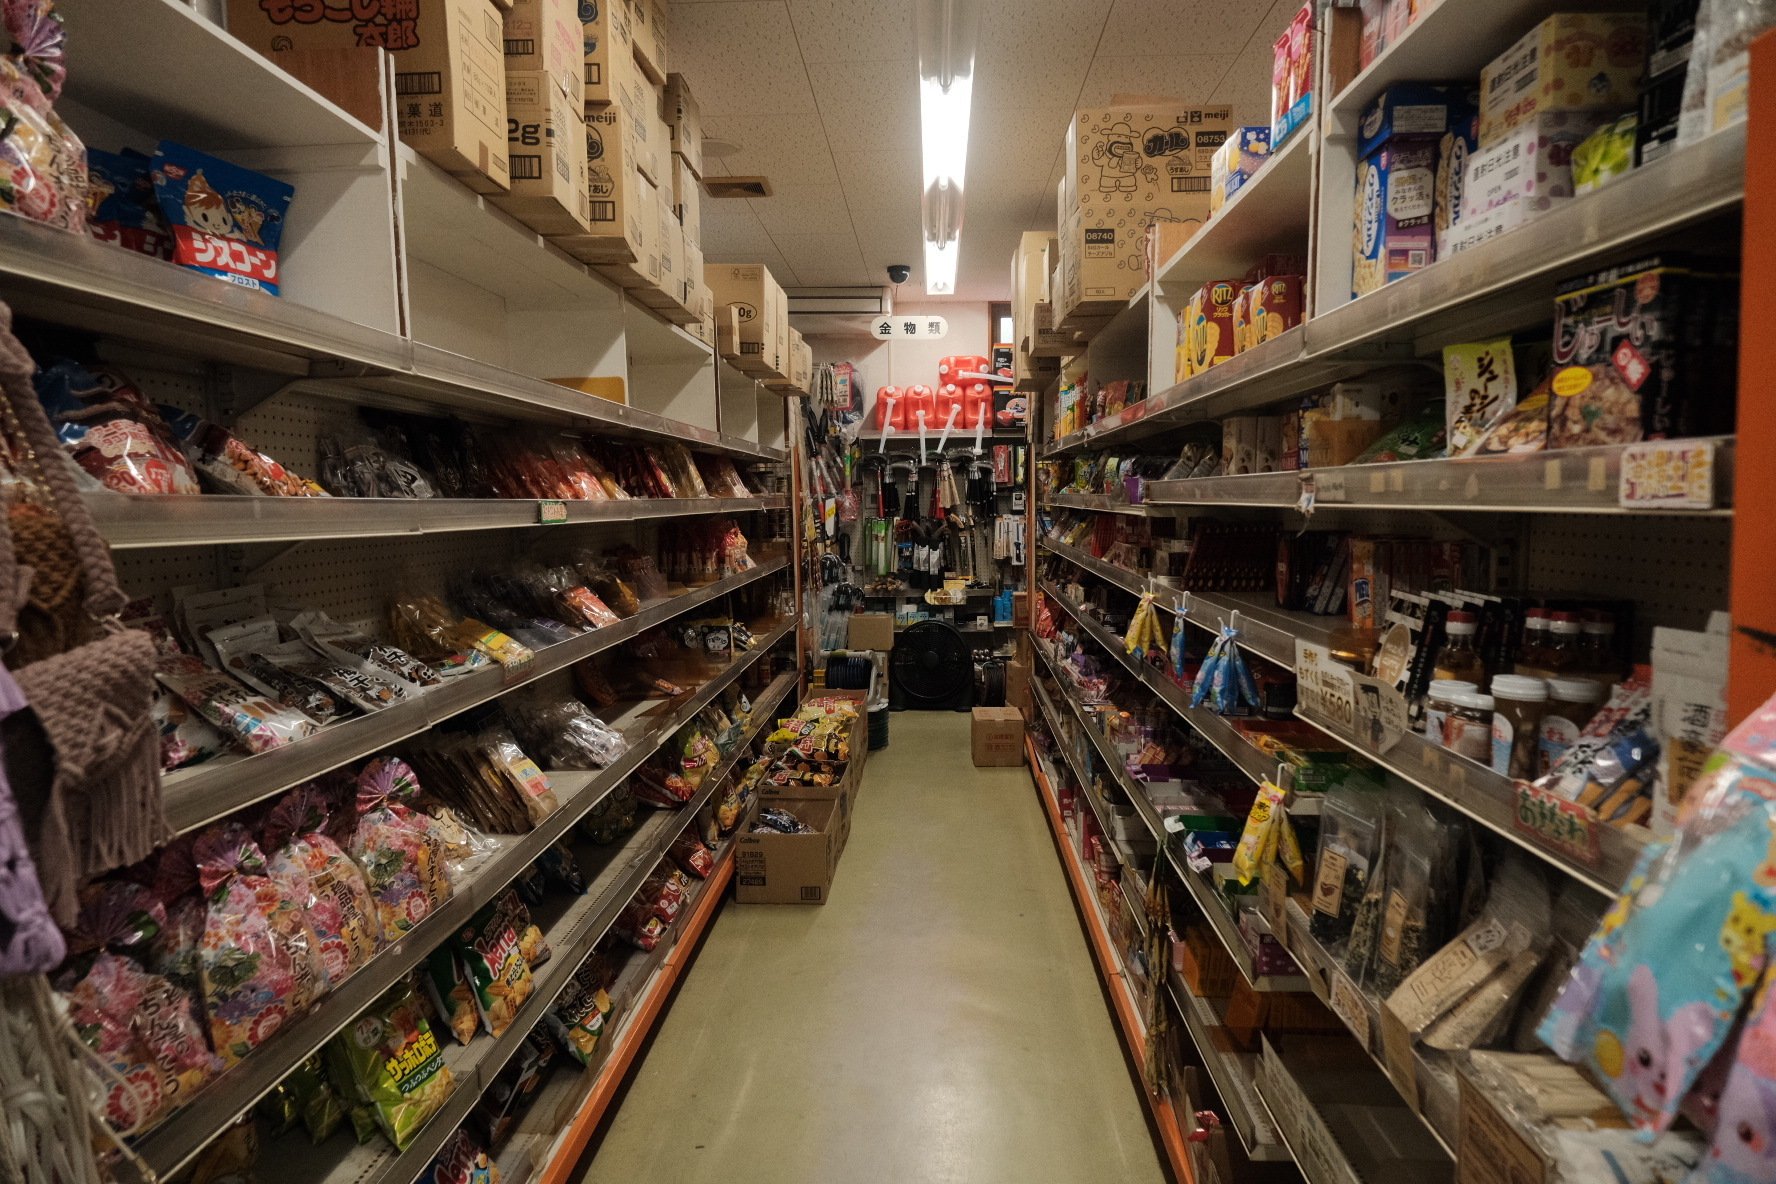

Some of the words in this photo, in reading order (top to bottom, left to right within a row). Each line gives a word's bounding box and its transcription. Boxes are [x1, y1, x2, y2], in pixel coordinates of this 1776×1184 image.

[584, 112, 617, 125] meiji
[1204, 110, 1229, 120] meiji
[1197, 134, 1225, 144] 08753
[1086, 232, 1114, 241] 08740
[230, 274, 258, 288] フロスト
[1213, 287, 1232, 303] RITZ
[879, 322, 941, 335] 金物類
